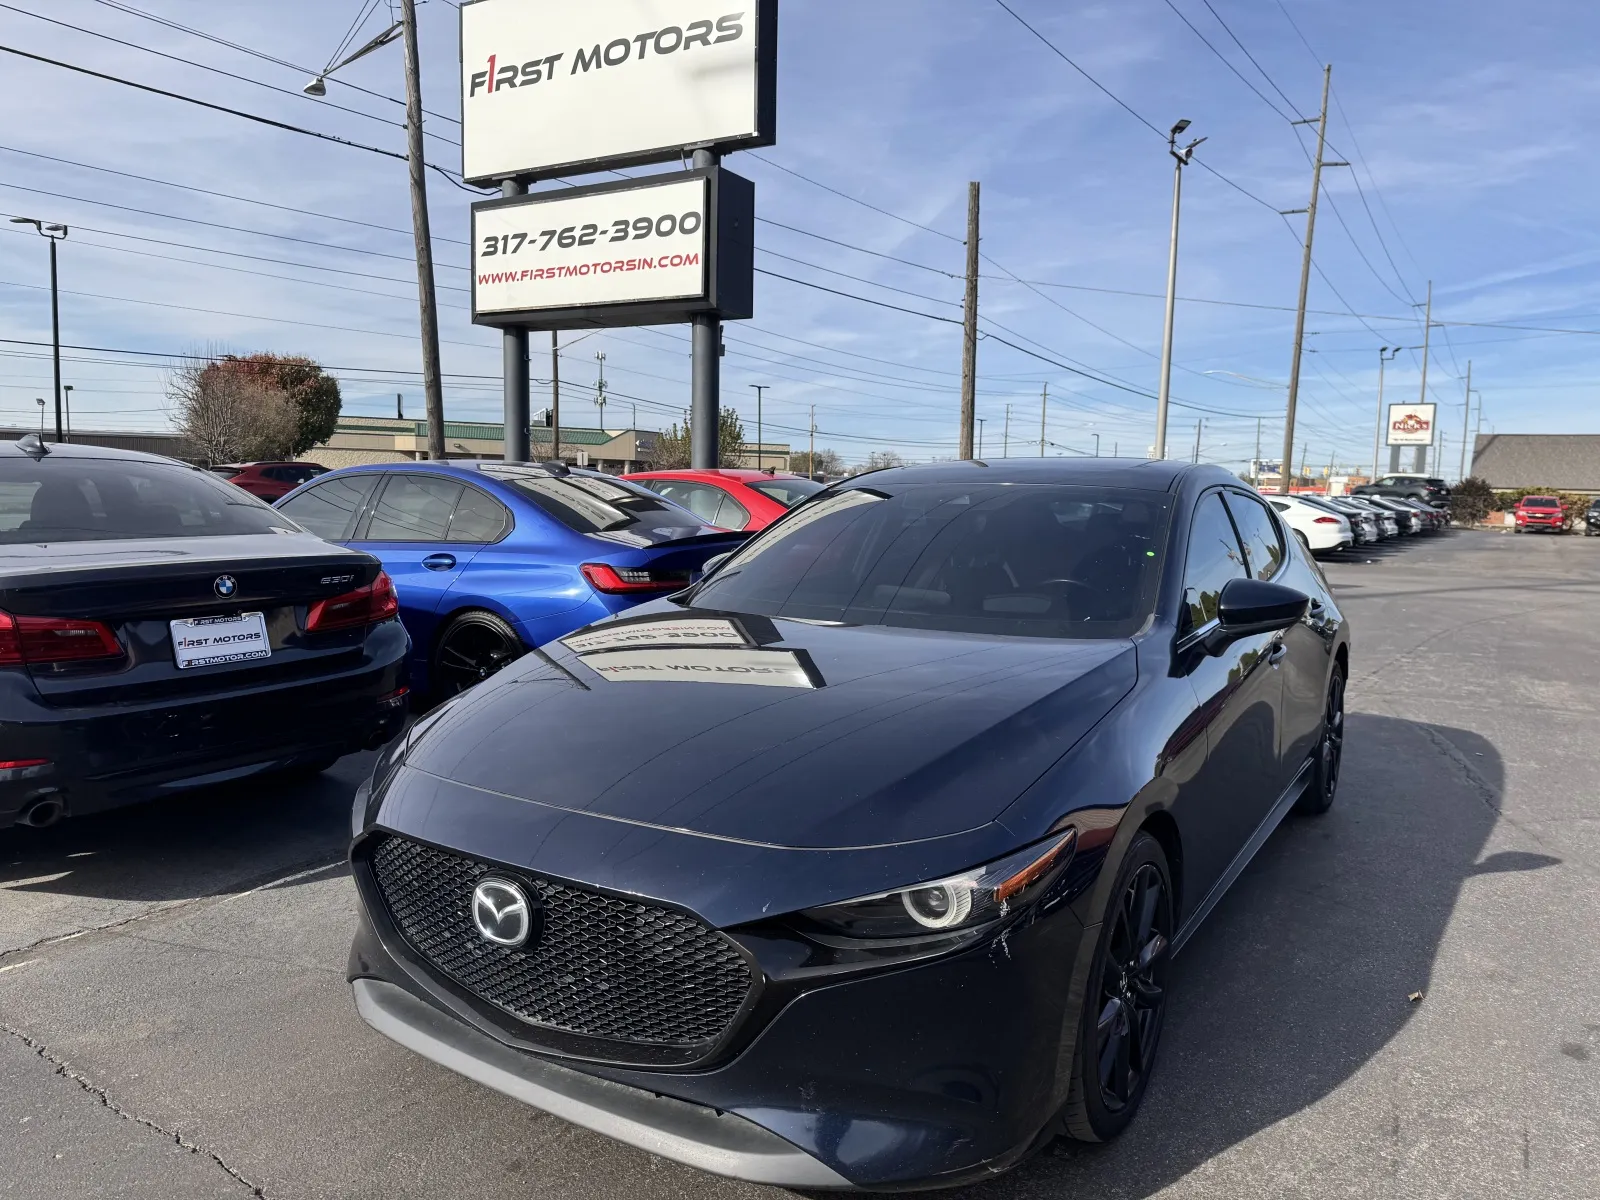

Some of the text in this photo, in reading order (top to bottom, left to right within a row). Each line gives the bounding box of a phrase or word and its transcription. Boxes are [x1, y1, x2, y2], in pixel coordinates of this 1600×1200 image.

[570, 12, 745, 75] MOTORS
[480, 211, 701, 257] 317-762-3900
[478, 253, 699, 285] WWW.FIRSTMOTORSIN.COM
[194, 618, 214, 626] FRST
[213, 632, 261, 644] MOTORS
